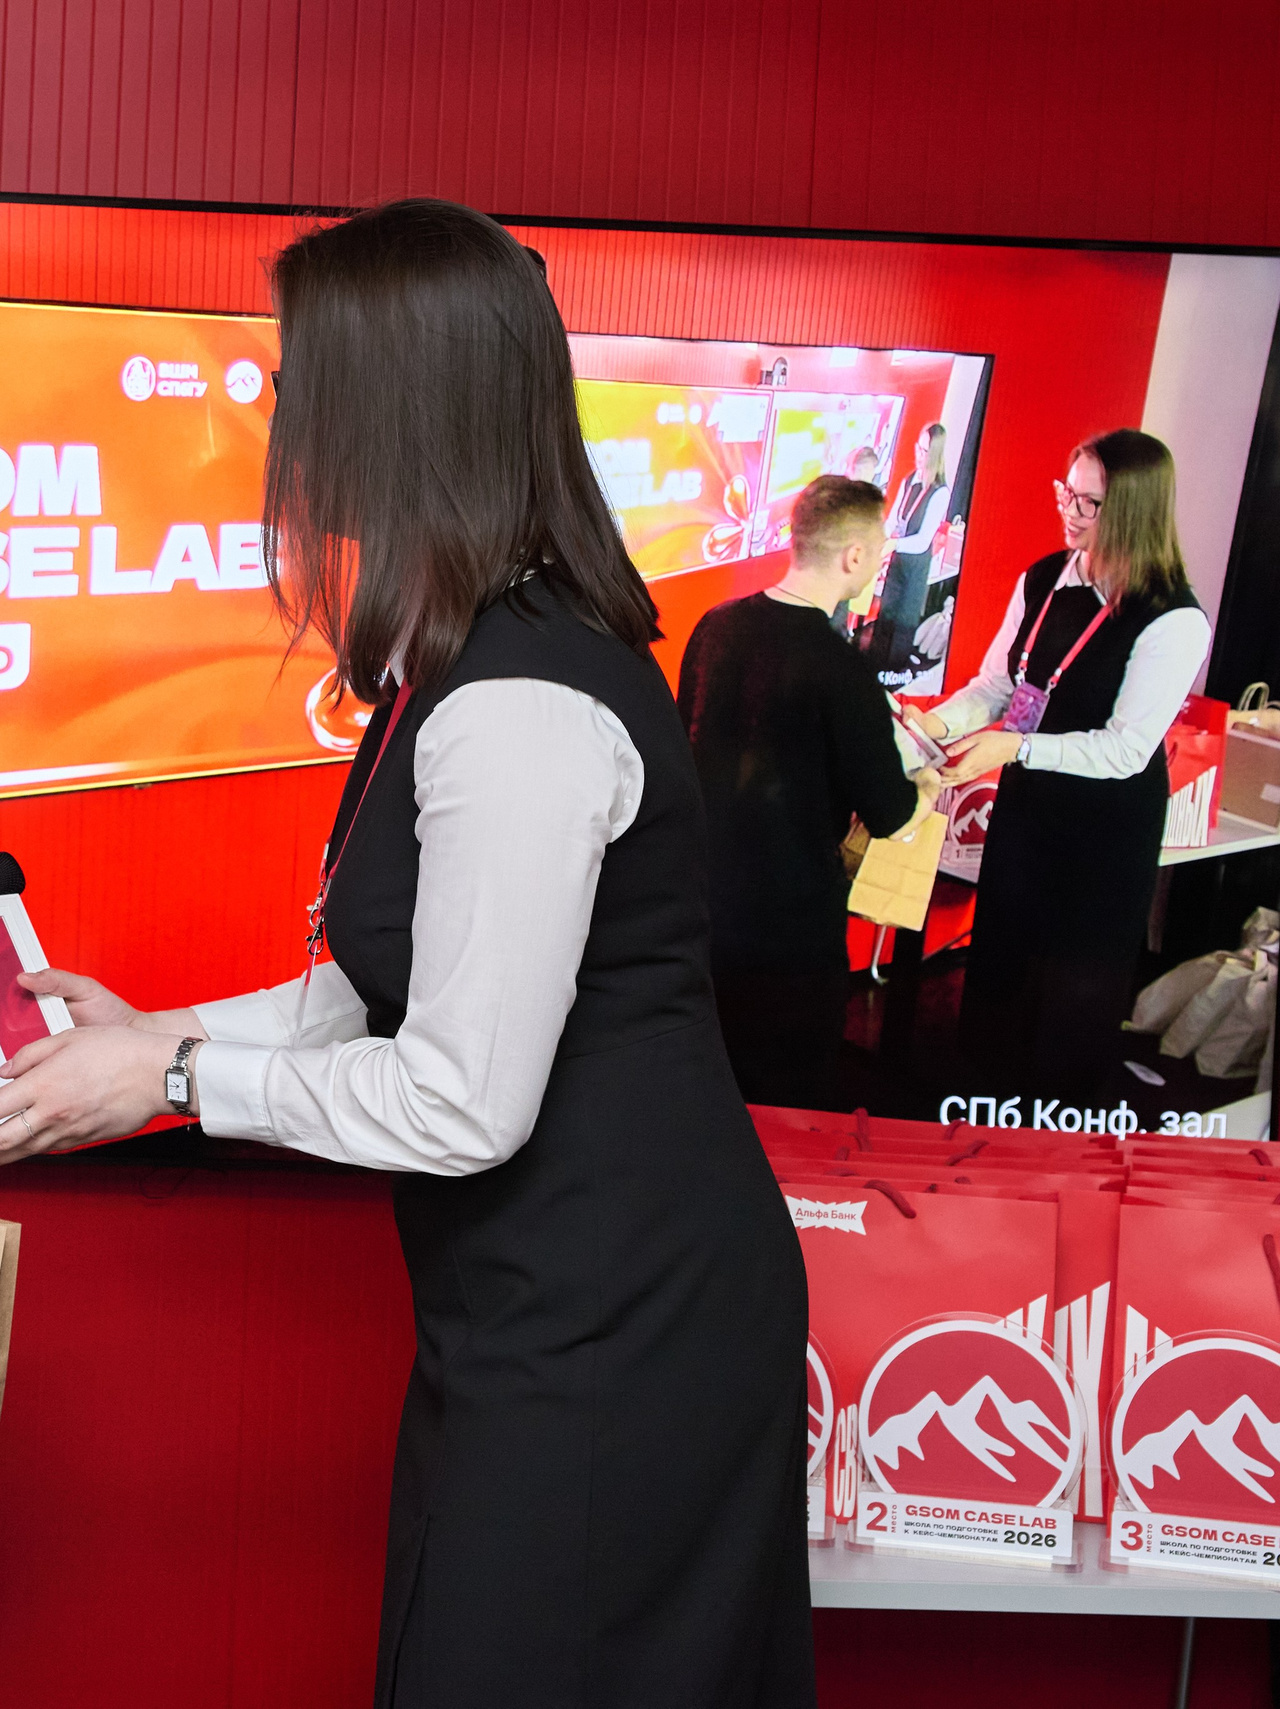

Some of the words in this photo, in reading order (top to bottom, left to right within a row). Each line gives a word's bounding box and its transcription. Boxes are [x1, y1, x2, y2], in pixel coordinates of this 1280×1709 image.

[938, 1096, 1021, 1129] СПб
[1032, 1098, 1147, 1141] Конф.
[1160, 1110, 1228, 1139] зал
[795, 1208, 828, 1220] Альфа
[831, 1210, 856, 1220] Банк
[866, 1502, 888, 1532] 2
[905, 1504, 960, 1521] GSOM
[964, 1510, 1016, 1526] CASE
[1018, 1515, 1058, 1530] LAB
[904, 1521, 931, 1529] ШКОЛА
[946, 1525, 999, 1535] ПОДГОТОВКЕ
[913, 1530, 999, 1543] КЕЙС-ЧЕМПИОНАТАМ
[1120, 1520, 1144, 1551] 3
[1161, 1524, 1218, 1541] GSOM
[1222, 1531, 1276, 1548] CASE
[1004, 1529, 1058, 1548] 2026
[1169, 1550, 1257, 1564] КЕЙС-ЧЕМПИОНАТАМ
[1203, 1545, 1257, 1556] ПОДГОТОВКЕ
